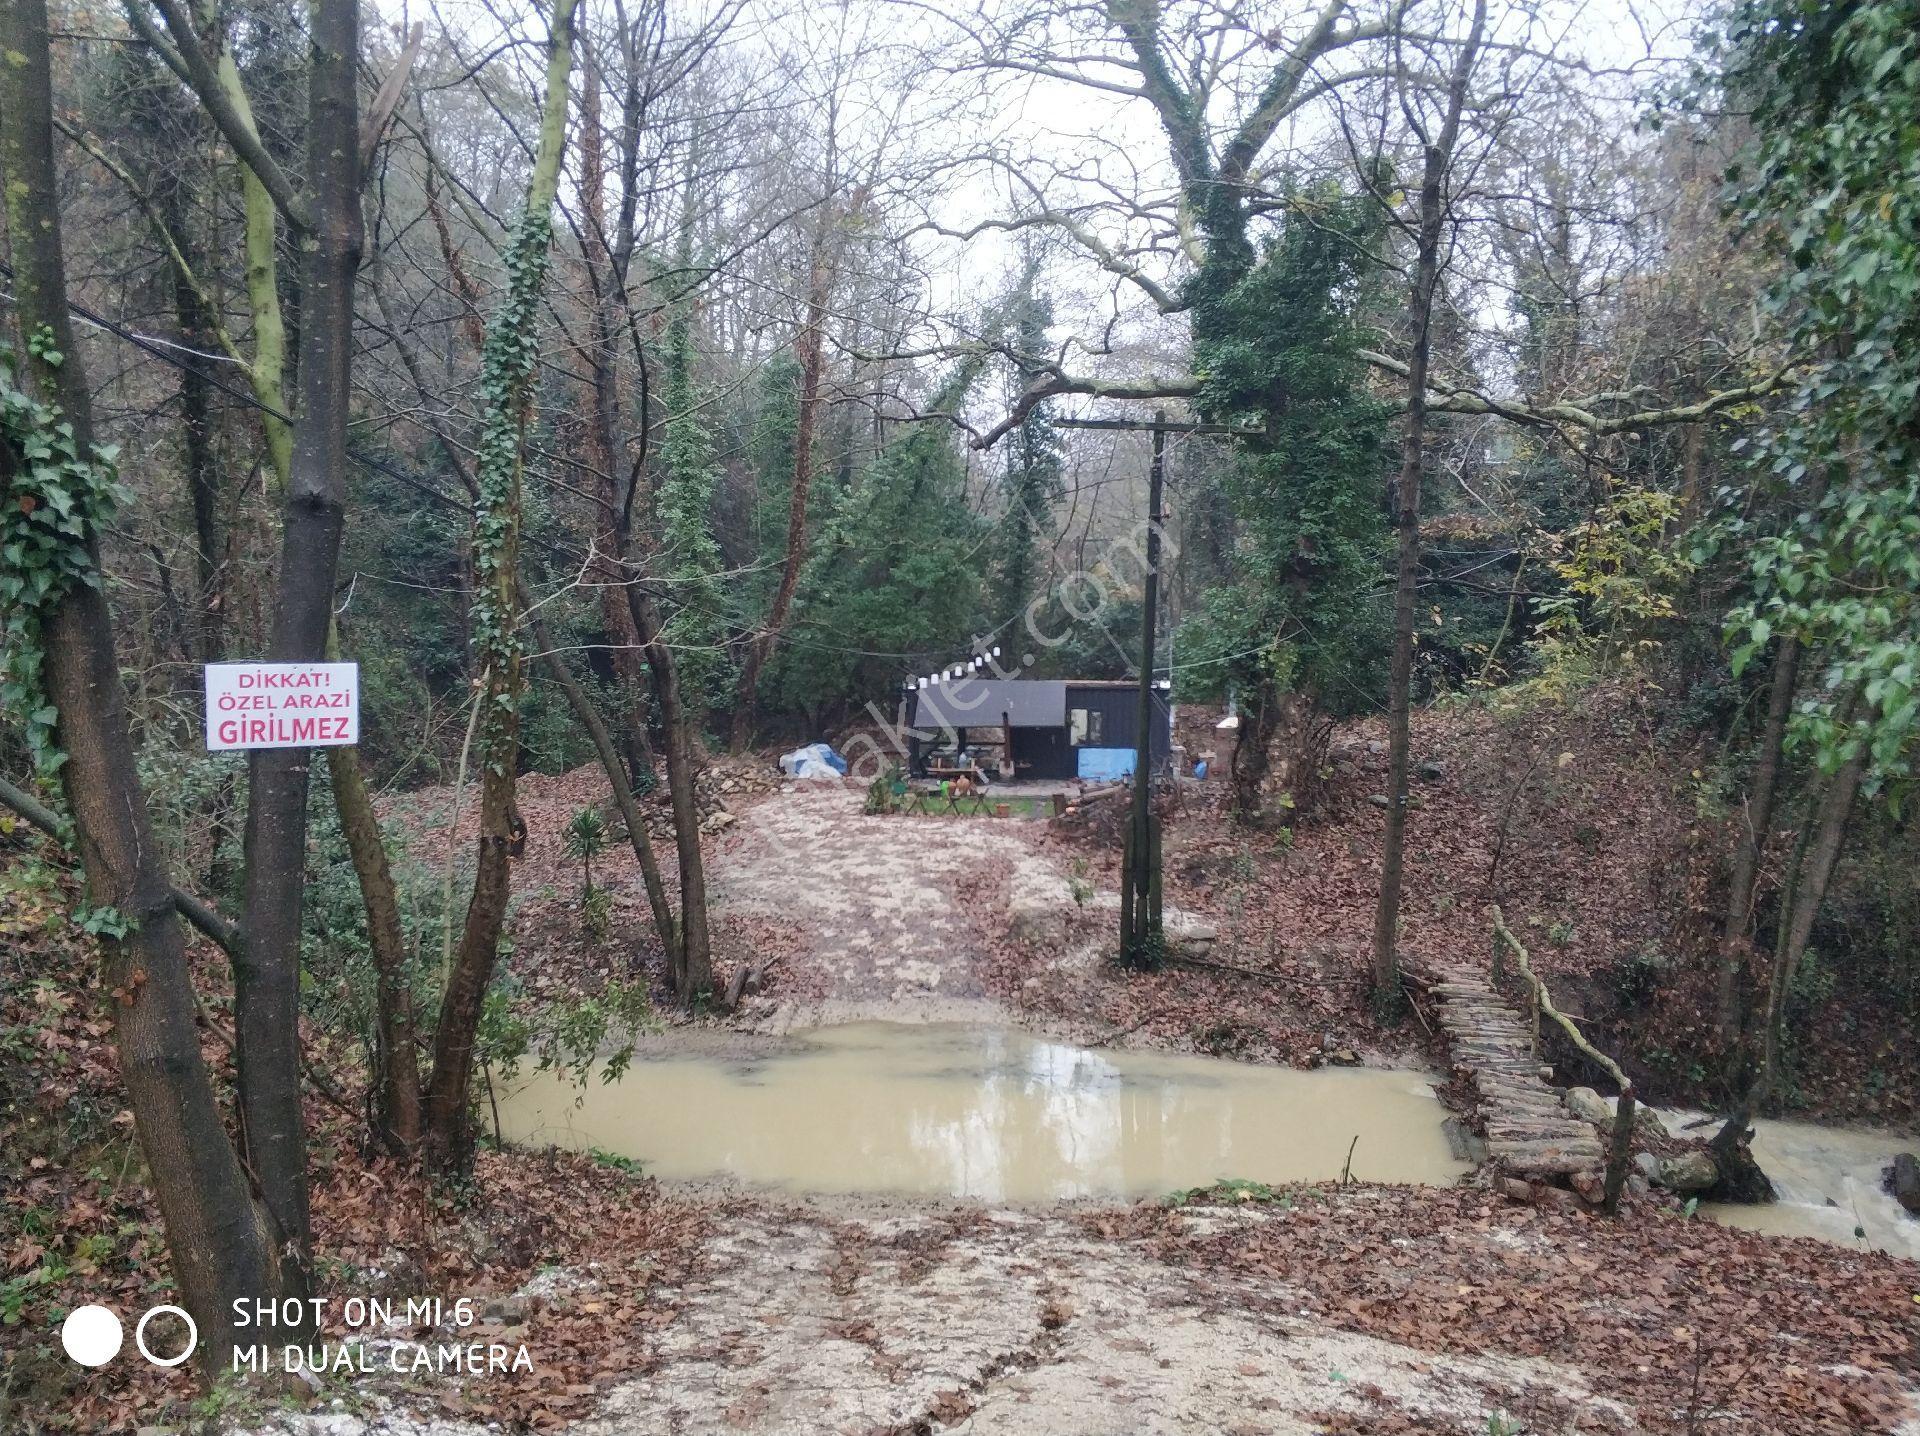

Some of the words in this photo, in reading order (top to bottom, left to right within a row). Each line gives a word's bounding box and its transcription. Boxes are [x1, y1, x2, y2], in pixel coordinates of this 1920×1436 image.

[239, 670, 330, 688] DİKKAT!
[218, 692, 278, 711] ÖZEL
[283, 689, 351, 709] ARAZİ
[219, 712, 350, 744] GİRİLMEZ
